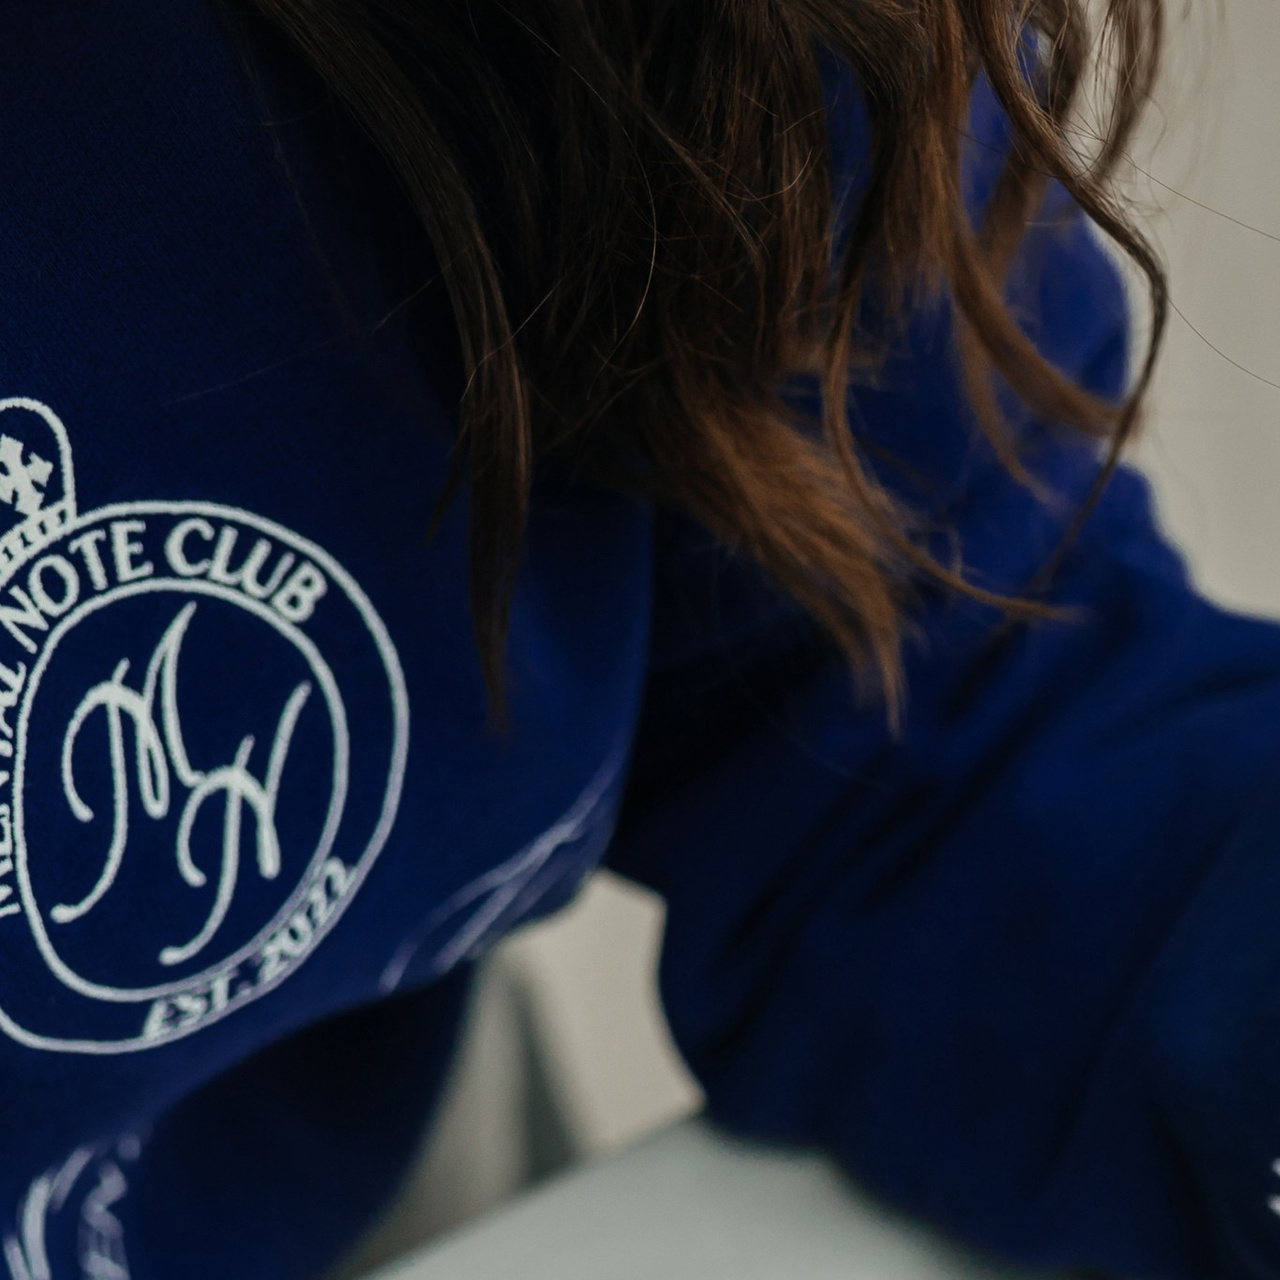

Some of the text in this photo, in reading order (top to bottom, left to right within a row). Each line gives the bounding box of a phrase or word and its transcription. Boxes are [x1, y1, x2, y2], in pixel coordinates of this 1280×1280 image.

[0, 517, 328, 654] NOTE CLUB
[256, 856, 358, 984] 2022
